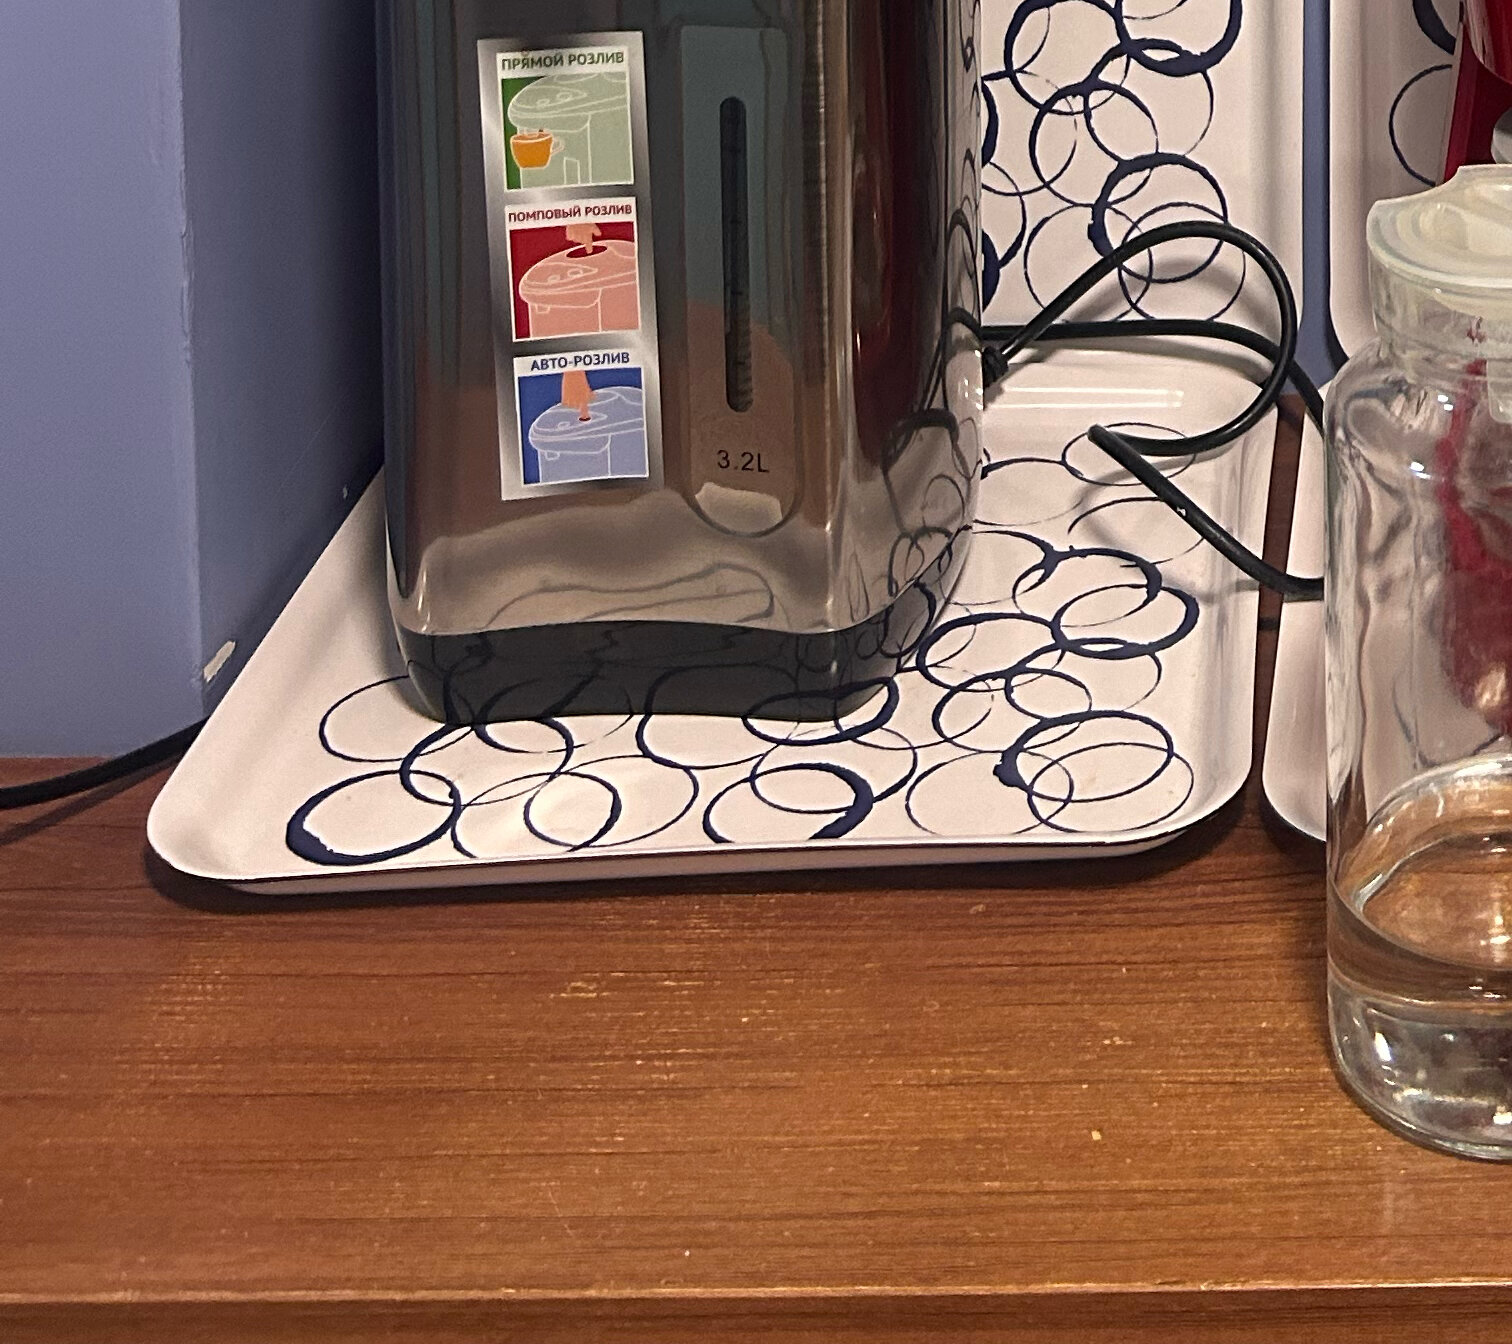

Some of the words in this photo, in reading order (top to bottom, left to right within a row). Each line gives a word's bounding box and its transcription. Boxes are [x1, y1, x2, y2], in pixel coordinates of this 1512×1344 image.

[501, 55, 564, 70] ПРЯМОЙ
[568, 51, 625, 67] РОЗЛИВ
[508, 205, 581, 222] ПОМПОВЫЙ
[584, 204, 633, 218] РОЗЛИВ
[530, 352, 630, 372] АВТО-РОЗЛИВ
[716, 449, 770, 473] 3.2L
